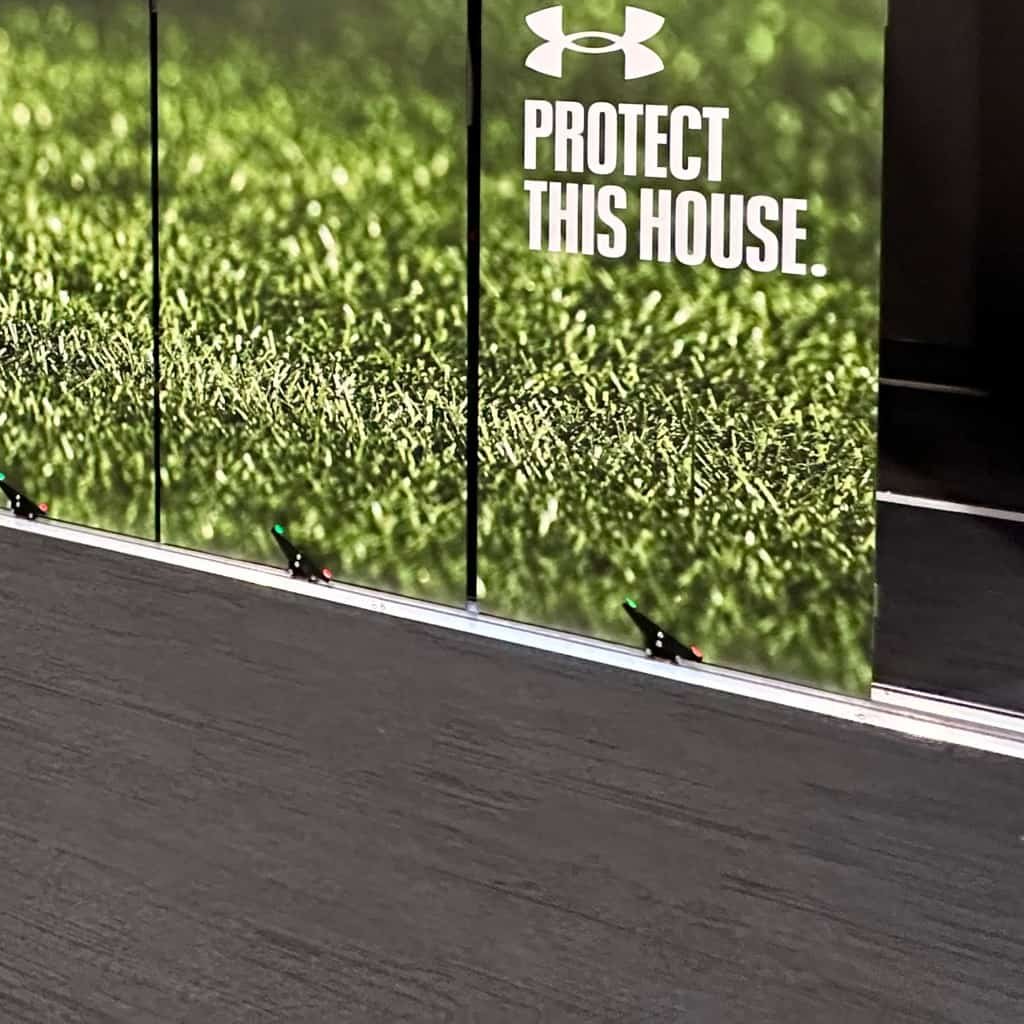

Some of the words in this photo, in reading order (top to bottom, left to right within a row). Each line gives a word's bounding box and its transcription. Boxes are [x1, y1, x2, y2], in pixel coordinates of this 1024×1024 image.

[524, 99, 730, 182] PROTECT
[523, 180, 628, 259] THIS
[639, 188, 828, 277] HOUSE.
